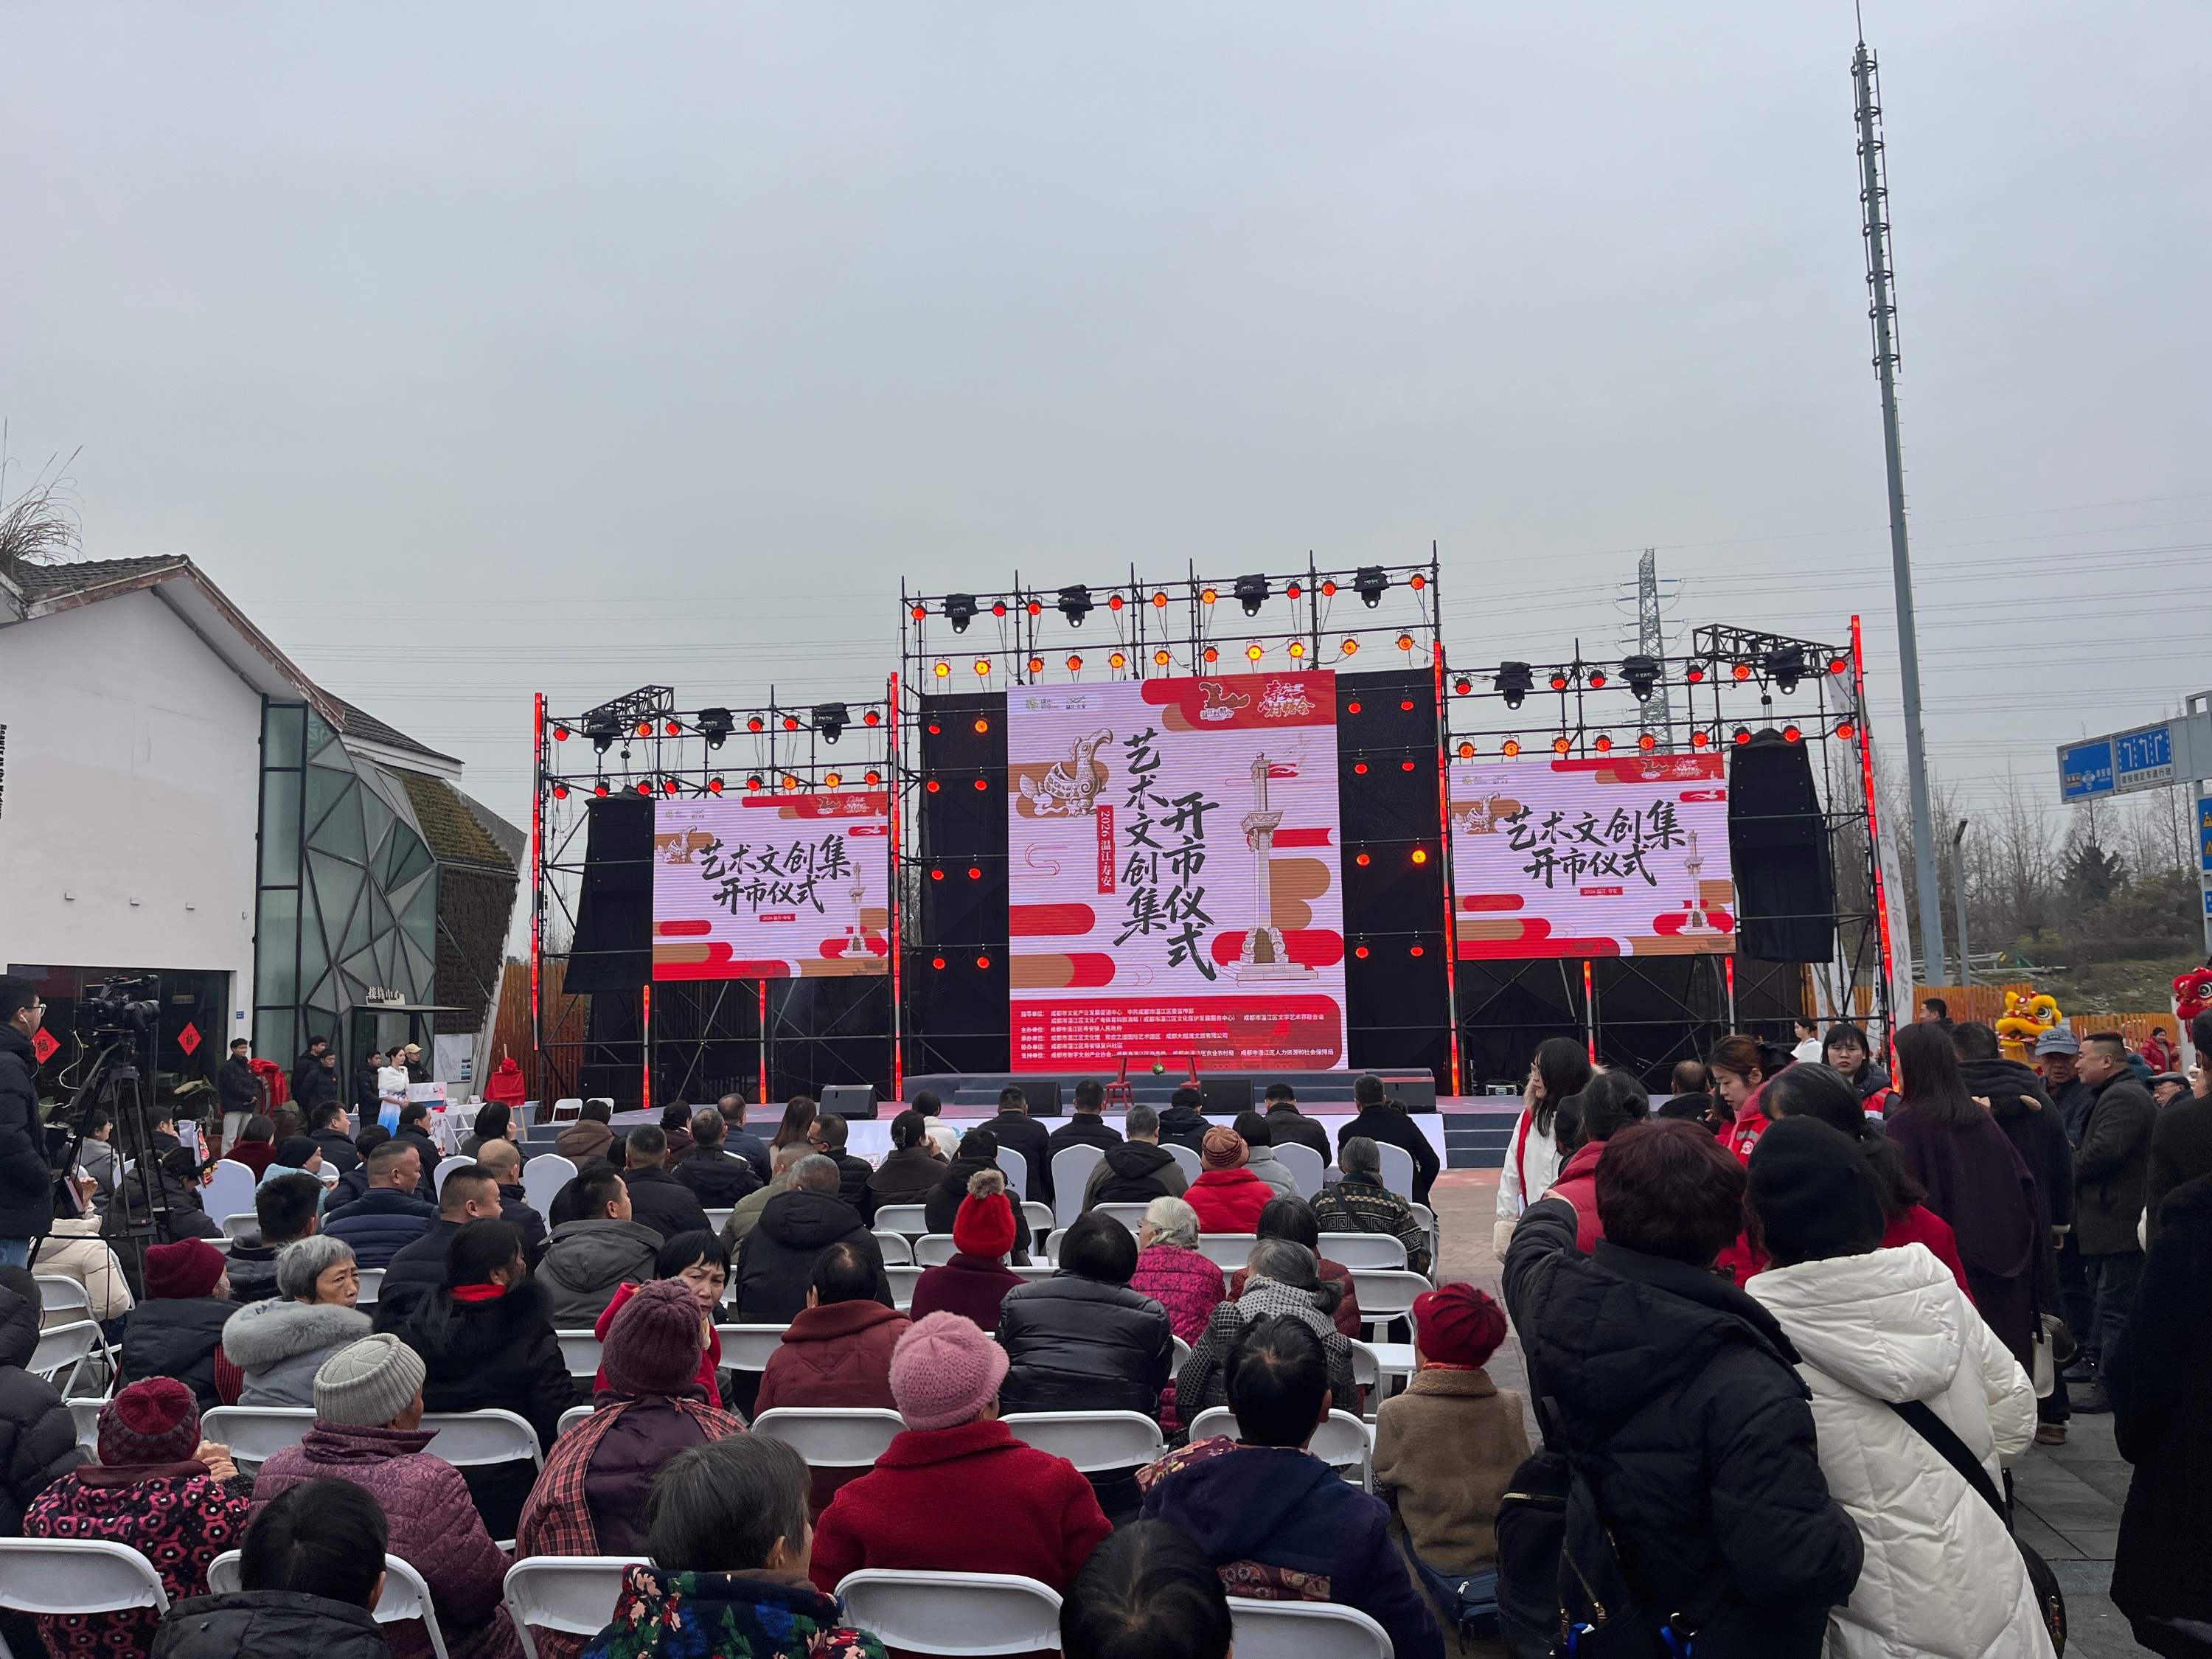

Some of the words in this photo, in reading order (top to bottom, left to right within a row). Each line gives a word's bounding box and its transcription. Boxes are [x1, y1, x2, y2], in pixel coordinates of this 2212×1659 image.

[1100, 810, 1110, 838] 2026
[1113, 727, 1168, 947] 艺术文创集
[1504, 799, 1686, 851] 艺术文创集
[699, 833, 851, 880] 艺术文创集
[1523, 844, 1658, 888] 开市仪式
[712, 874, 825, 915] 开市仪式
[1160, 792, 1220, 981] 开市仪式
